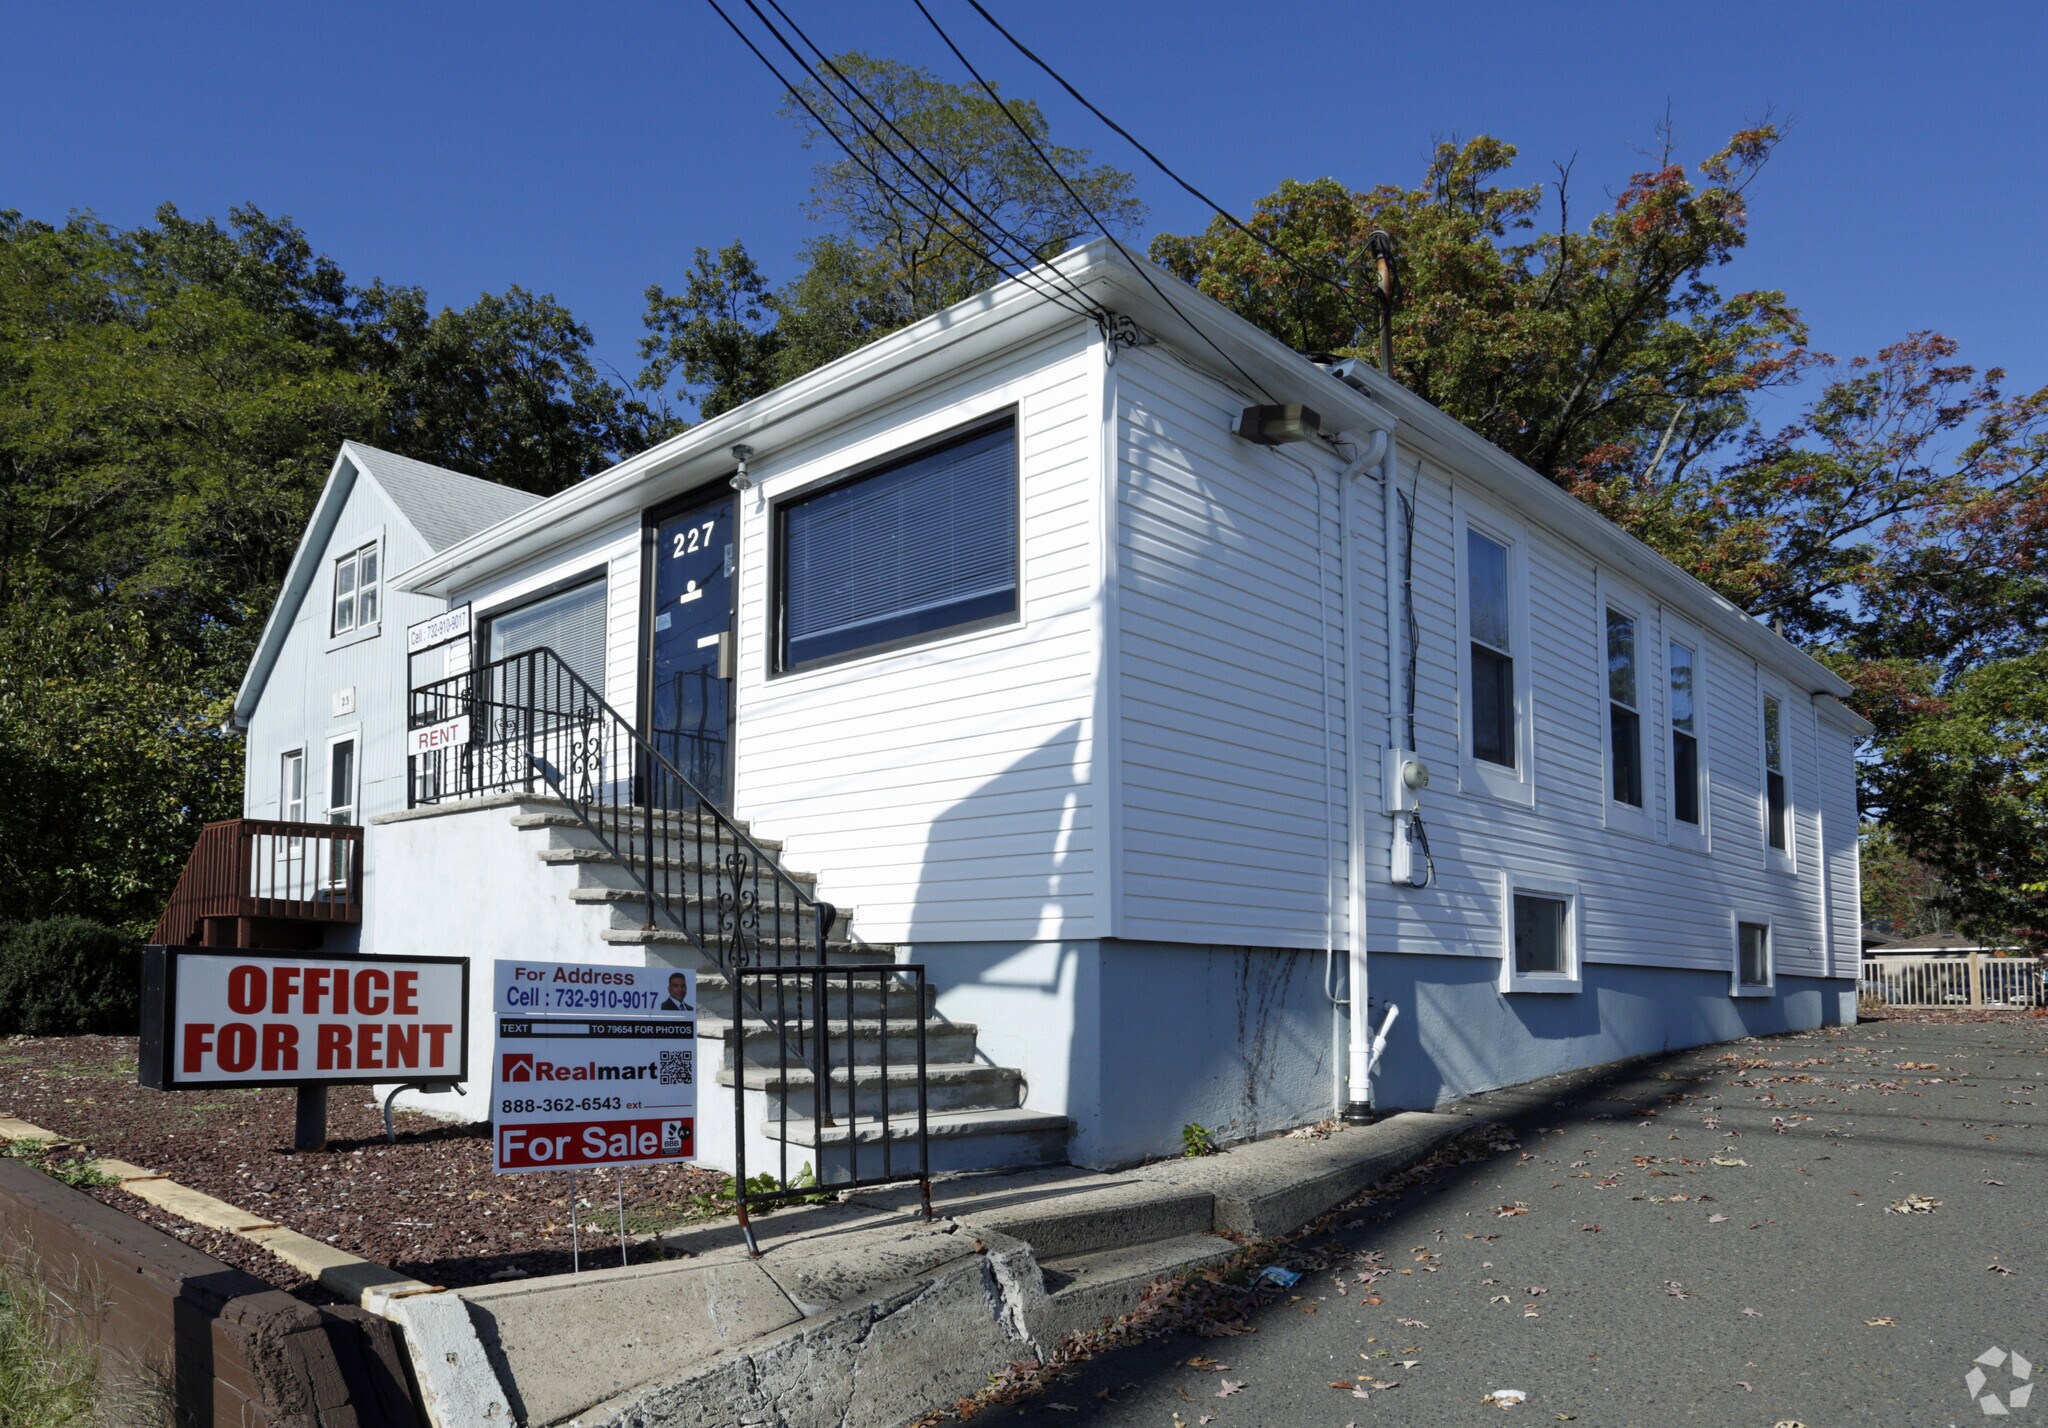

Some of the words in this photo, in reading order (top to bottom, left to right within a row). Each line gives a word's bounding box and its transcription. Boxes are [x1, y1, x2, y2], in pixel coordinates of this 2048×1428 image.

[673, 521, 715, 558] 227
[410, 629, 422, 645] Cell
[427, 612, 466, 639] 732-910-9017
[419, 725, 459, 749] RENT
[515, 967, 546, 981] For
[552, 967, 635, 986] Address
[228, 965, 419, 1016] OFFICE
[507, 986, 539, 1006] Cell
[555, 988, 659, 1009] 732-910-9017
[501, 1023, 528, 1033] TEXT
[591, 1024, 605, 1033] TO
[607, 1024, 633, 1034] 79654
[634, 1025, 653, 1034] FOR
[655, 1025, 692, 1035] PHOTOS
[183, 1023, 300, 1073] FOR
[317, 1024, 453, 1070] RENT
[535, 1061, 658, 1081] Realmart
[502, 1097, 621, 1113] 888-362-6543
[626, 1102, 642, 1110] ext
[502, 1129, 572, 1163] For
[581, 1125, 658, 1159] Sale
